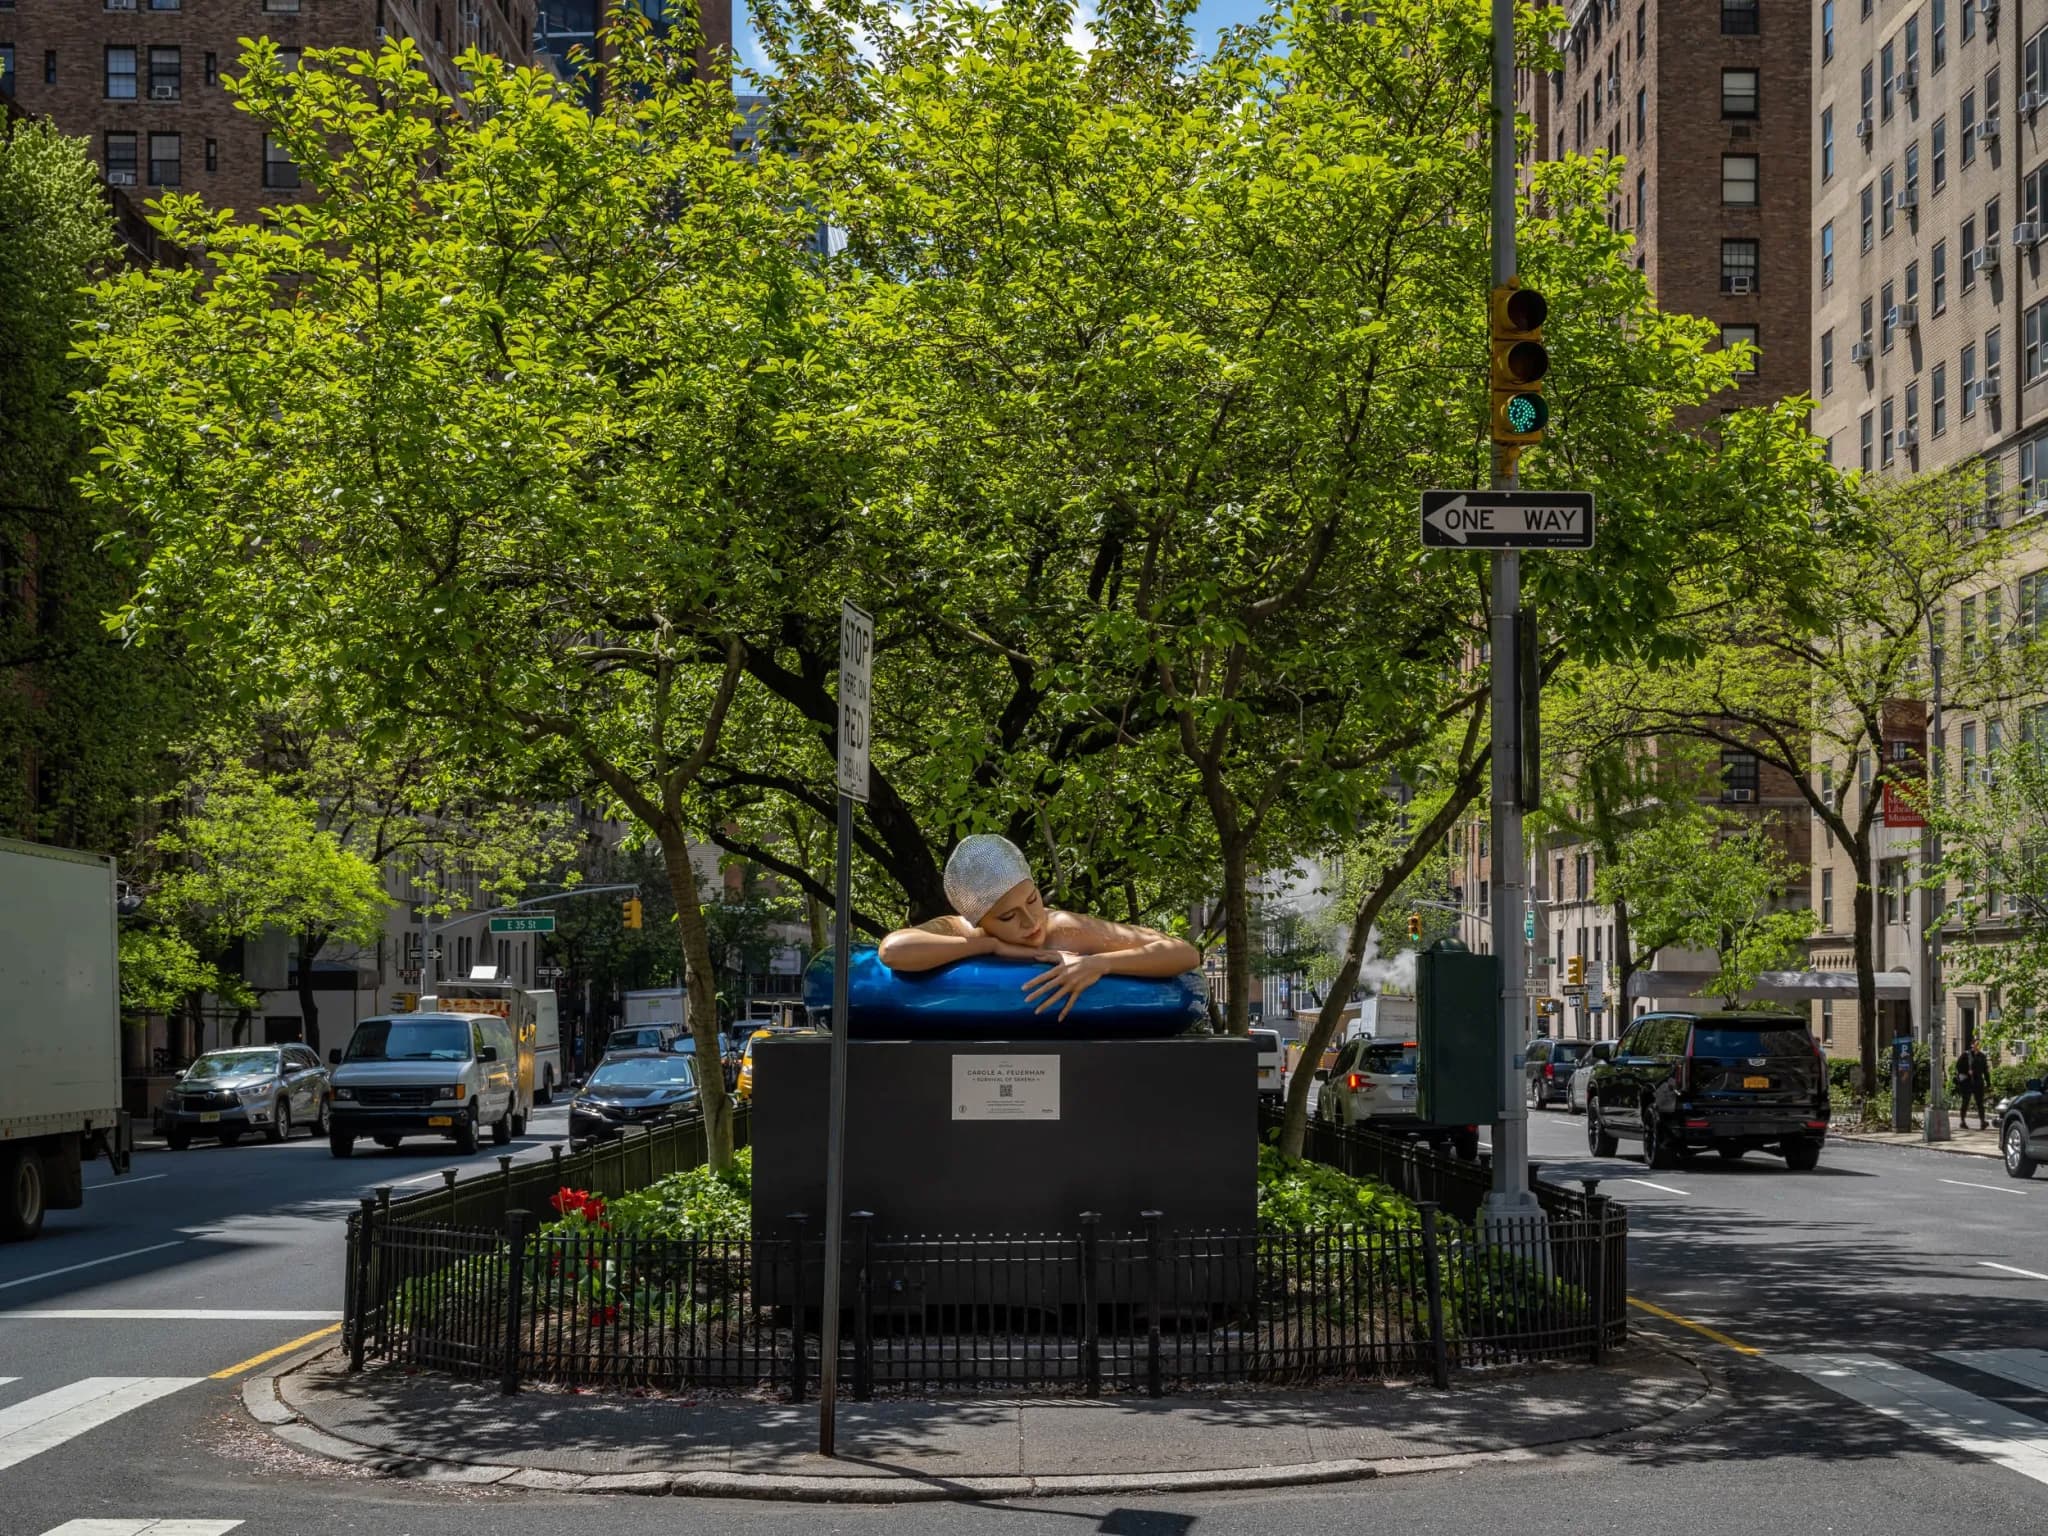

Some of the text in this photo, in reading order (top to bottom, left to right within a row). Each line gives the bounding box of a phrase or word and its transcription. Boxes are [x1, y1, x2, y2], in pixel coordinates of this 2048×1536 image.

[1444, 508, 1578, 532] ONE WAY
[843, 617, 870, 669] STOP
[843, 671, 868, 701] HERE ON
[843, 703, 864, 751] RED
[843, 755, 863, 783] SIGNAL
[507, 919, 536, 930] E 35 St
